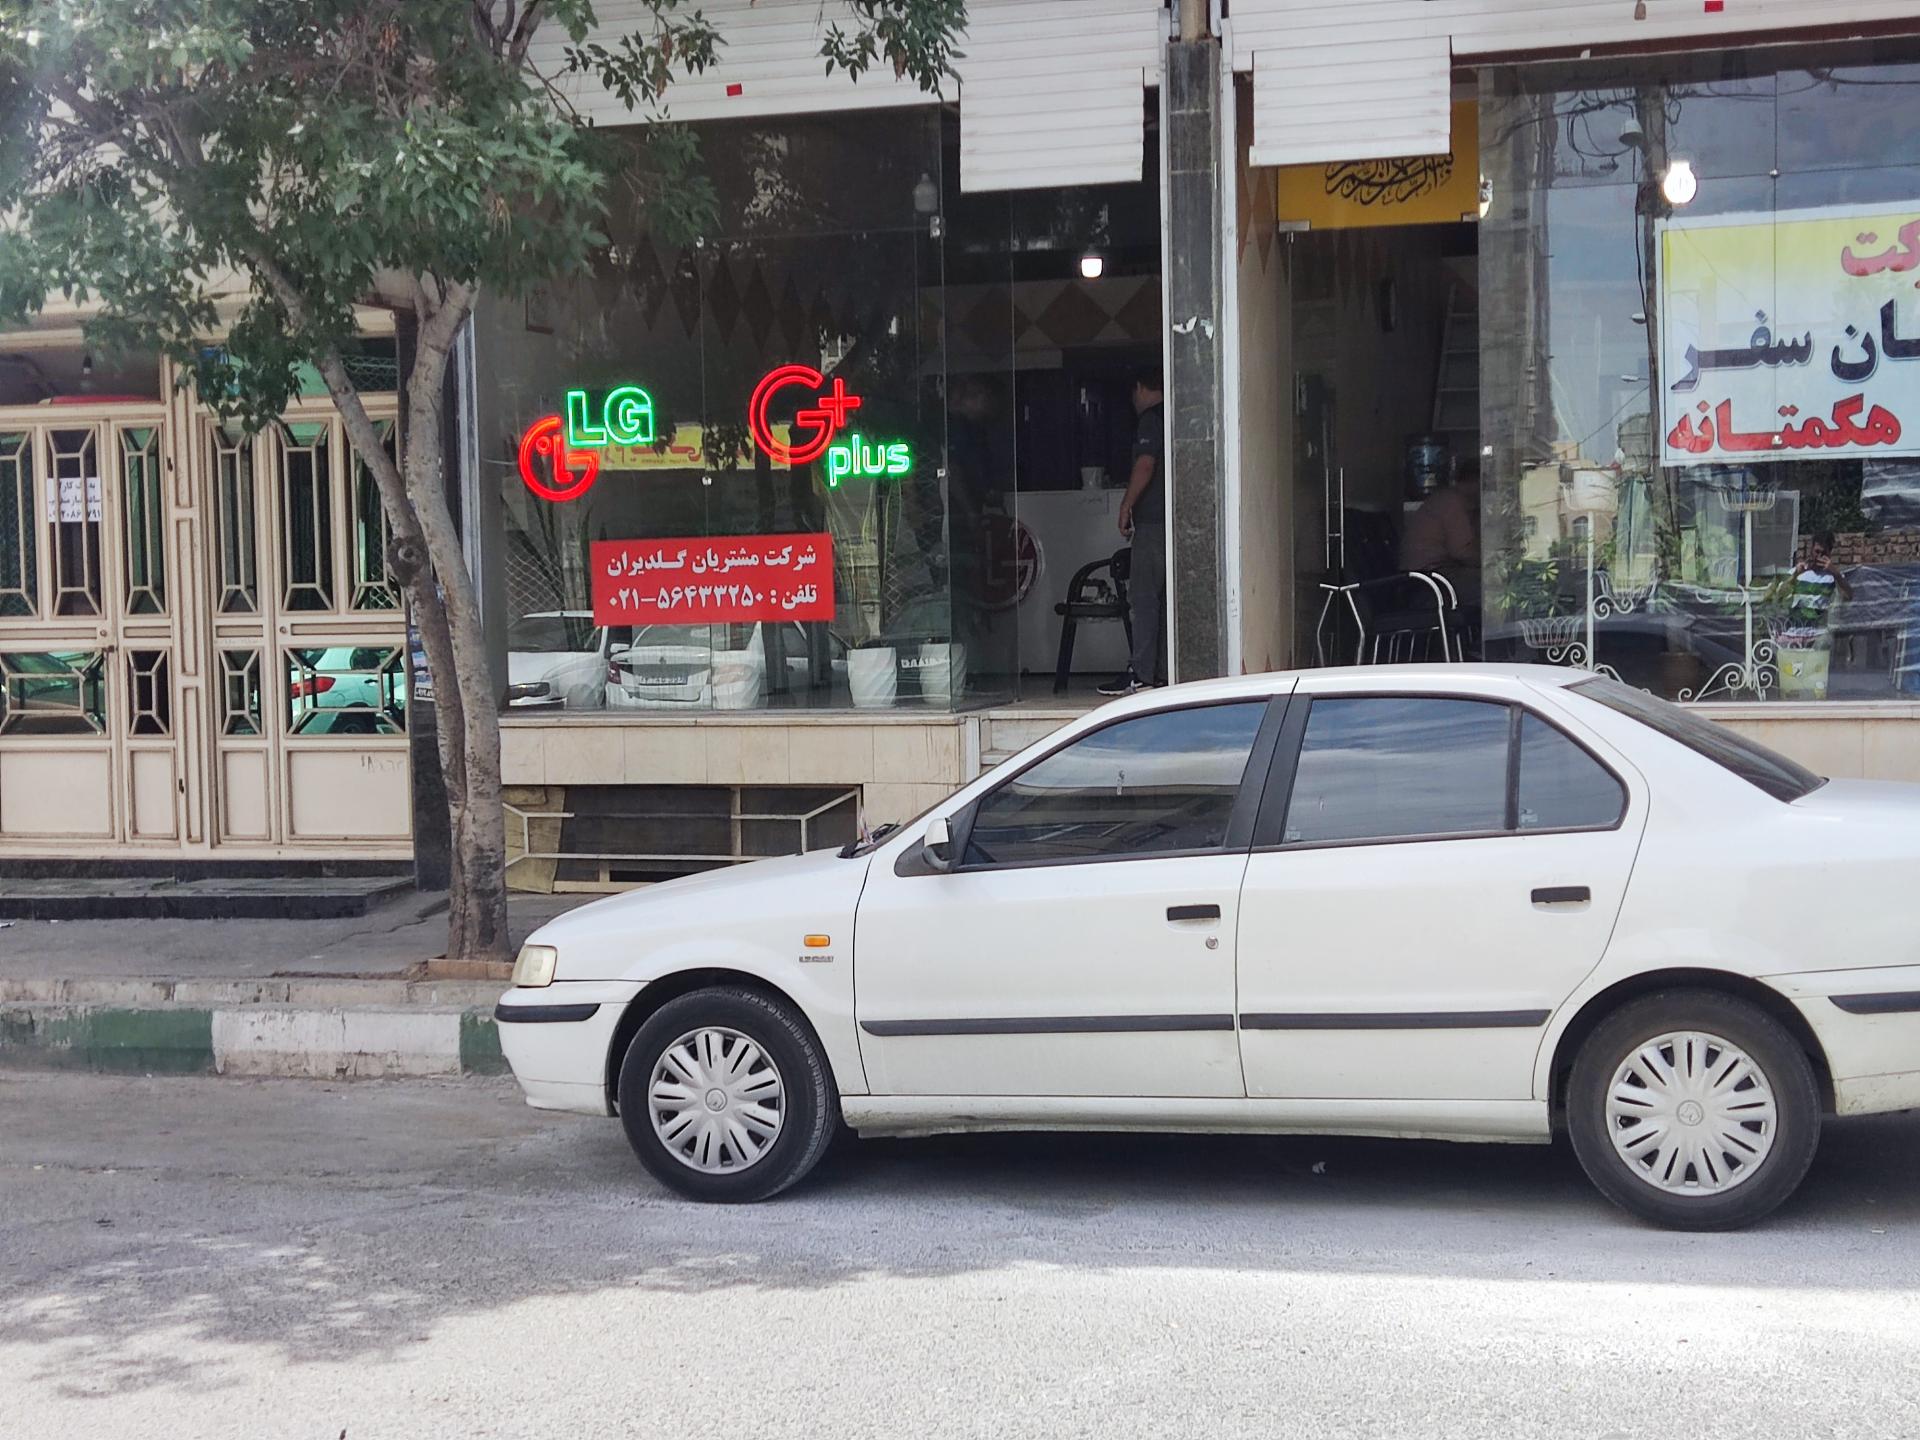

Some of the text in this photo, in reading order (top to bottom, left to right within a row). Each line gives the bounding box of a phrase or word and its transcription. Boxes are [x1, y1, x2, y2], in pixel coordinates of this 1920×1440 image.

[1841, 217, 1920, 282] کت
[1671, 309, 1814, 393] سفر
[566, 386, 655, 446] LG
[827, 434, 911, 486] plus
[607, 545, 816, 577] شرکت مشتریان گلدیران
